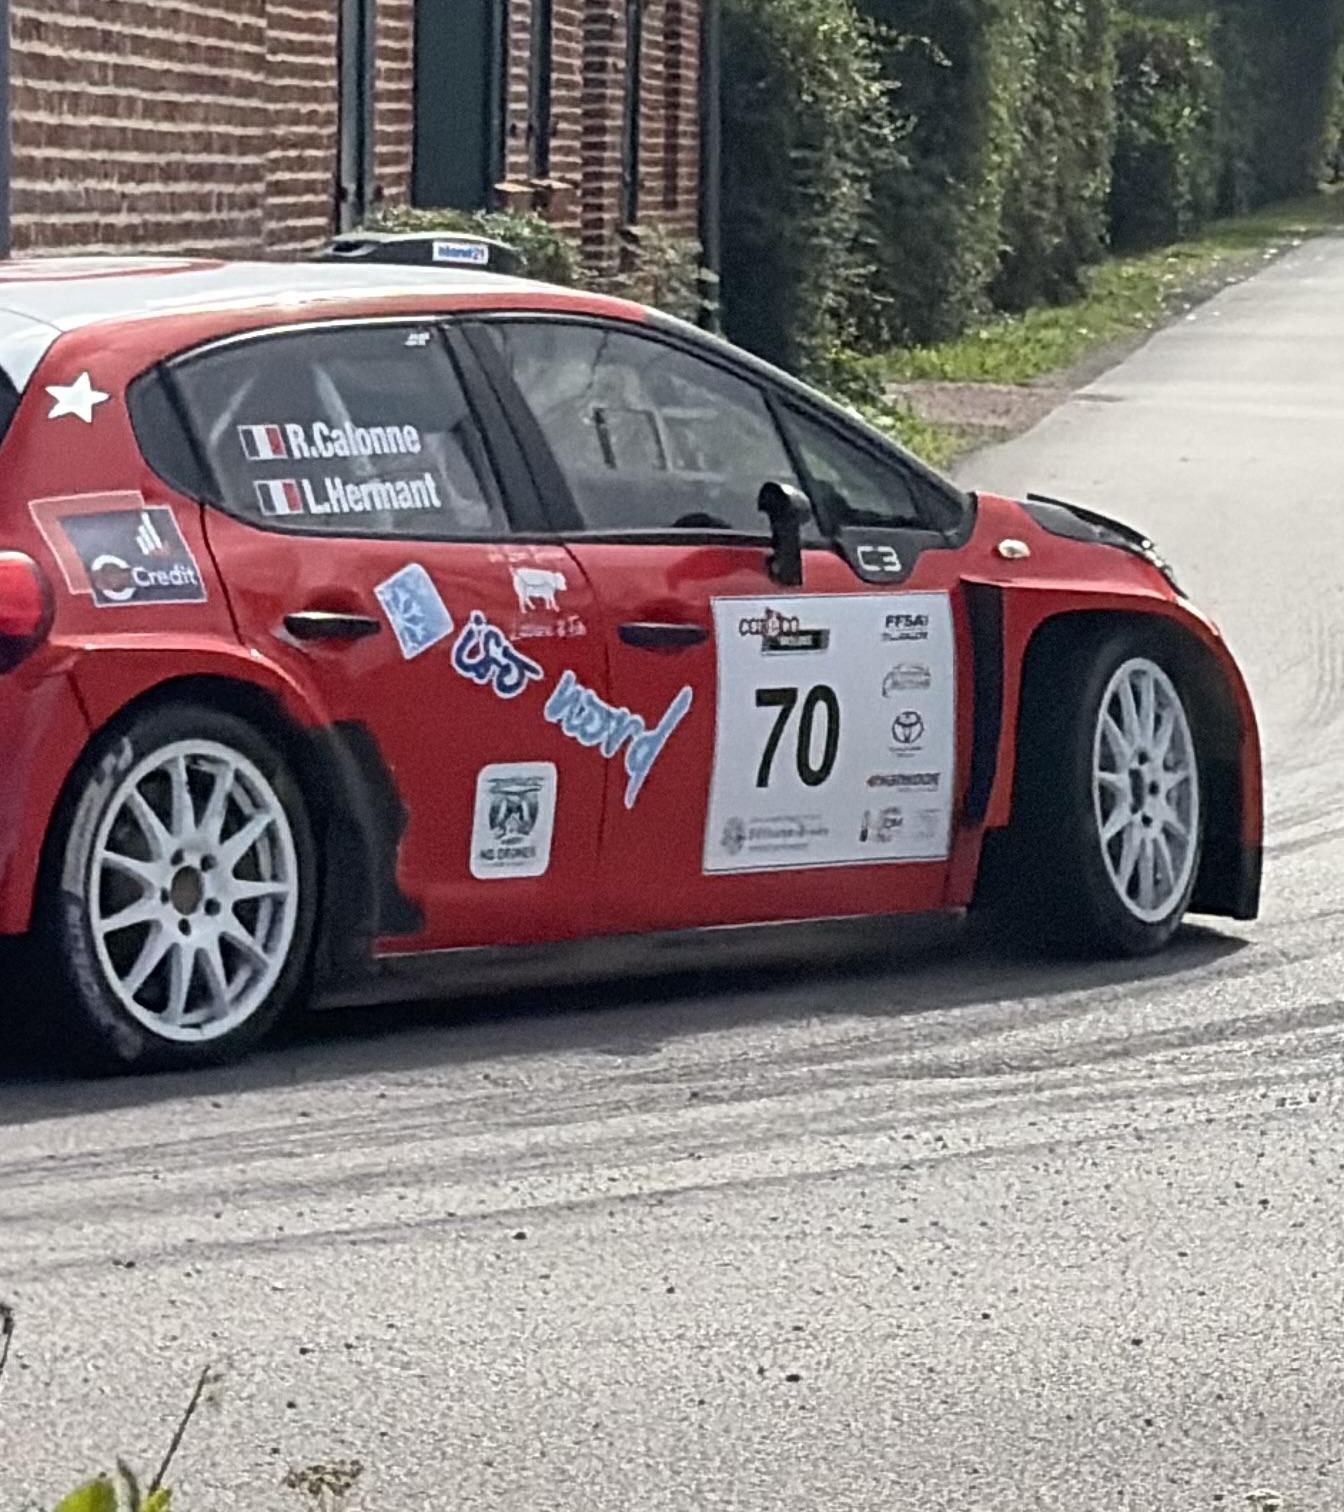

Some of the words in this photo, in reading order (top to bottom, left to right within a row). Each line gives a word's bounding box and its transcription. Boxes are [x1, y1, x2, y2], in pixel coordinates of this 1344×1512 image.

[285, 421, 422, 459] R.Calonne
[302, 472, 442, 514] L.Hermant
[131, 564, 198, 587] Credit
[857, 546, 902, 572] C3
[755, 684, 840, 788] 70
